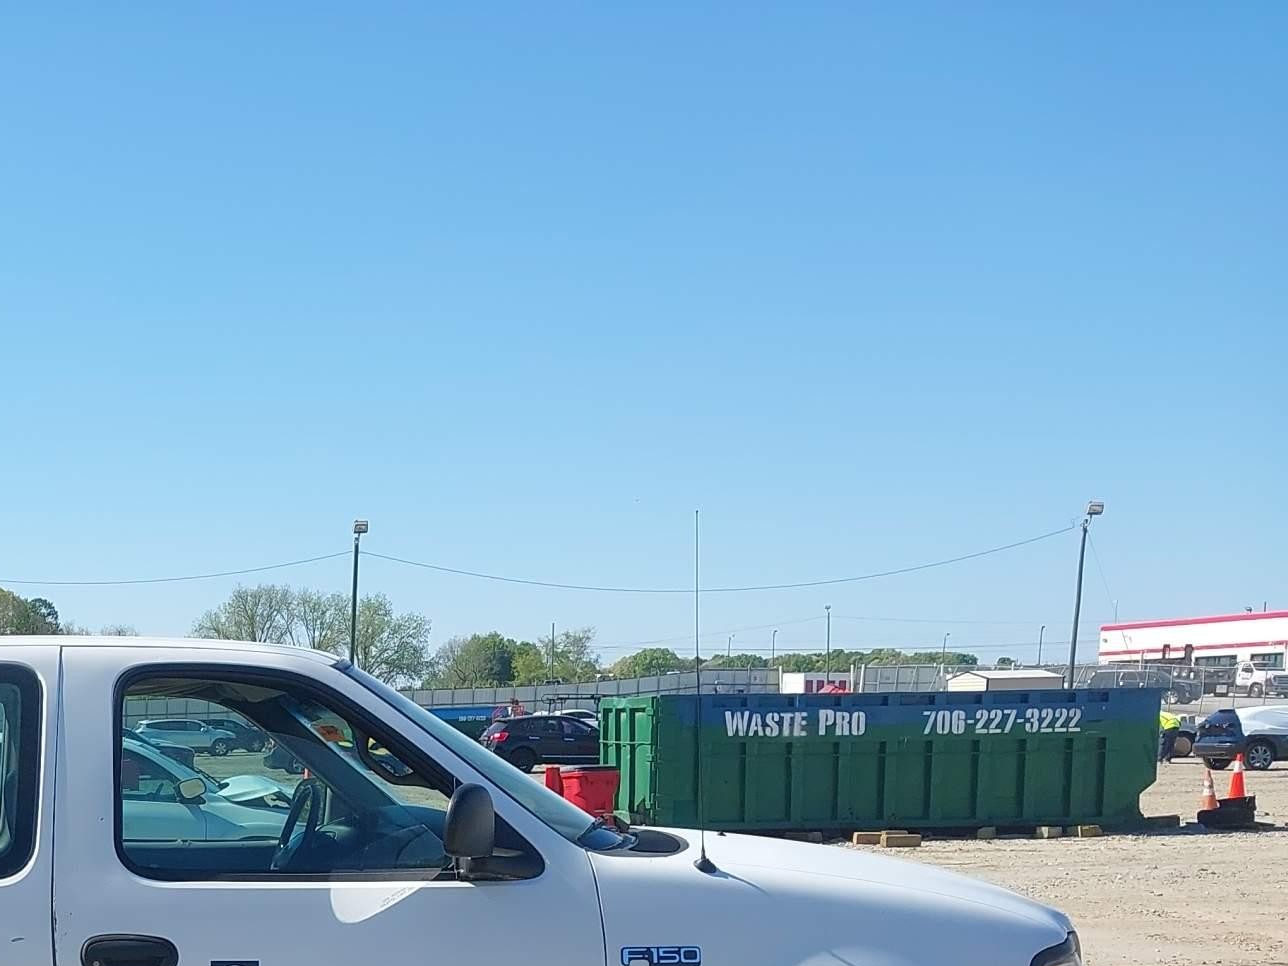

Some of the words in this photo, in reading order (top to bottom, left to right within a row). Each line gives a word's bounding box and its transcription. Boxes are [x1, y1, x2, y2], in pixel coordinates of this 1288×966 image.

[725, 711, 807, 736] WASTE
[819, 710, 866, 735] PRO
[923, 709, 1081, 734] 706-227-3222
